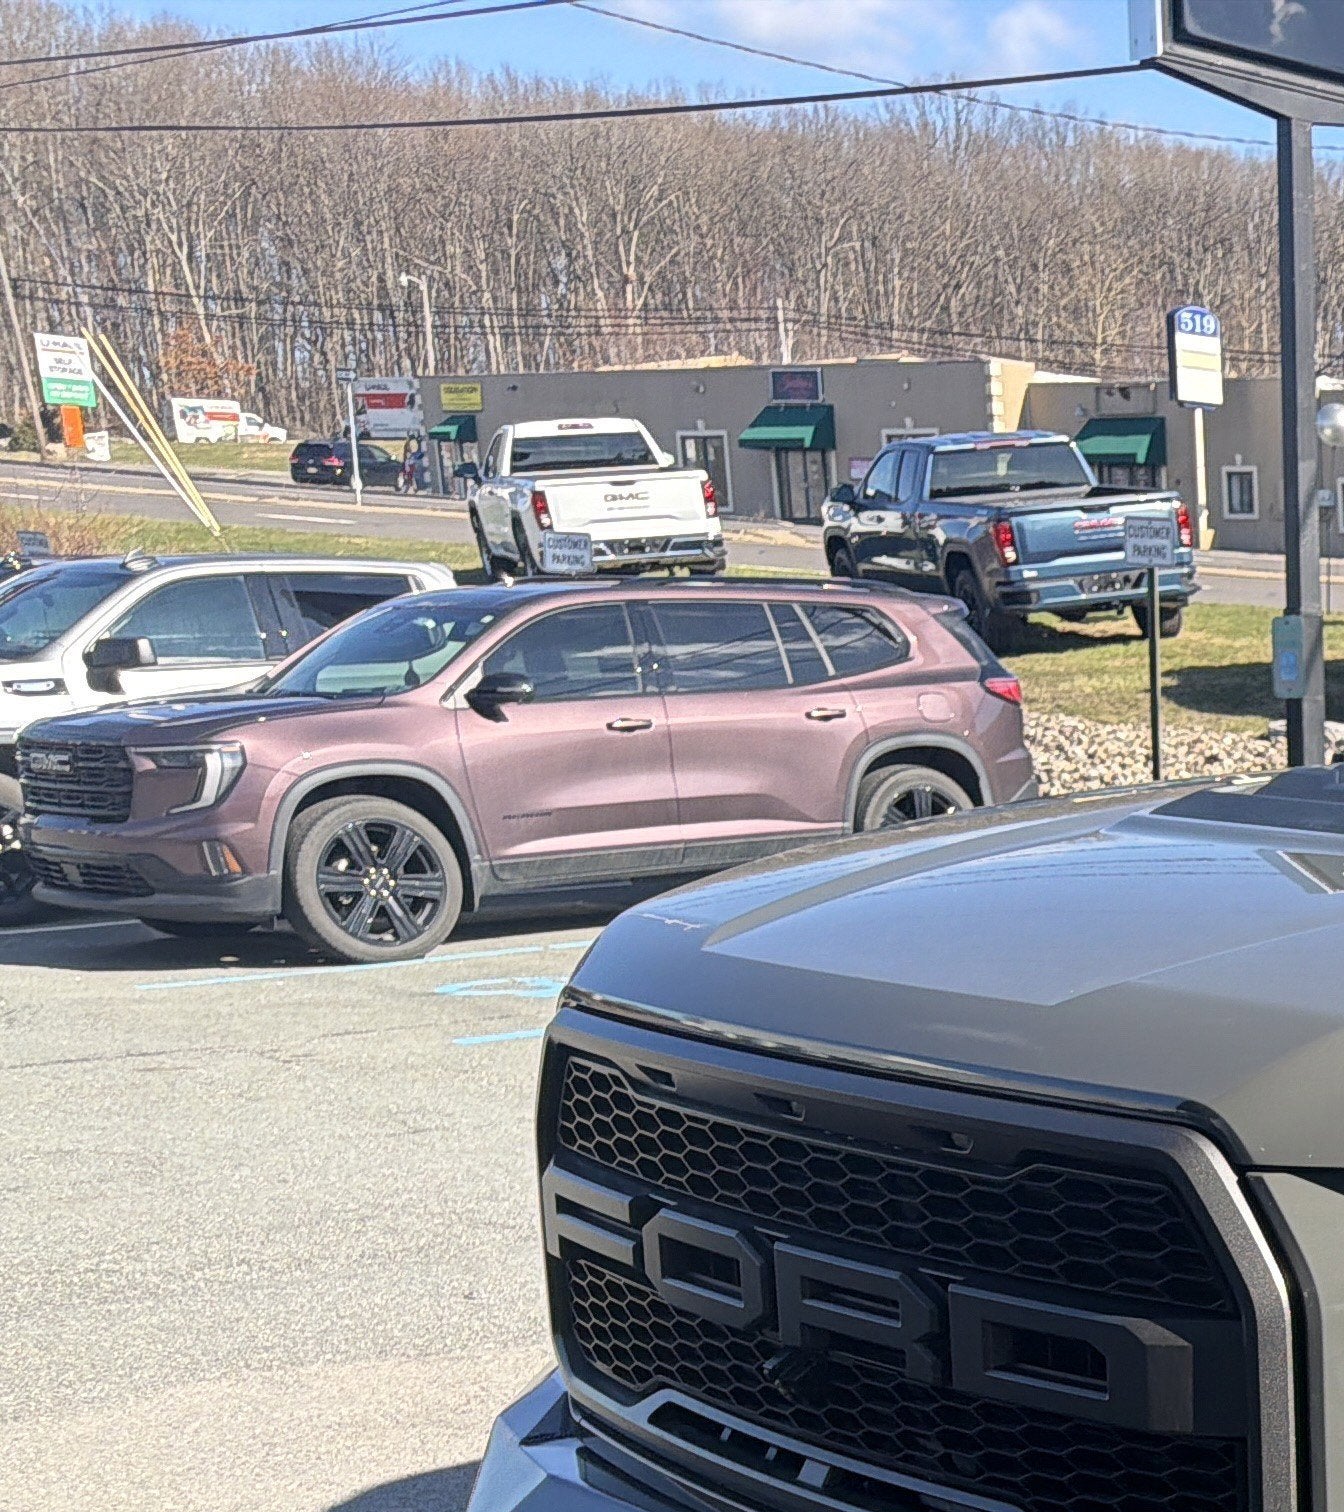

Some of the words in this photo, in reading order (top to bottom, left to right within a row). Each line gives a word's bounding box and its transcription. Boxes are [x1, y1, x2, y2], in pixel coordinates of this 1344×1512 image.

[1180, 312, 1216, 335] 519
[603, 491, 650, 503] GMC
[1128, 524, 1171, 540] CUSTOMER
[547, 537, 589, 551] CUSTOMER
[1131, 543, 1168, 560] PARKING
[551, 552, 586, 567] PARKING
[29, 752, 71, 773] GMC
[543, 1163, 1194, 1433] FORD
